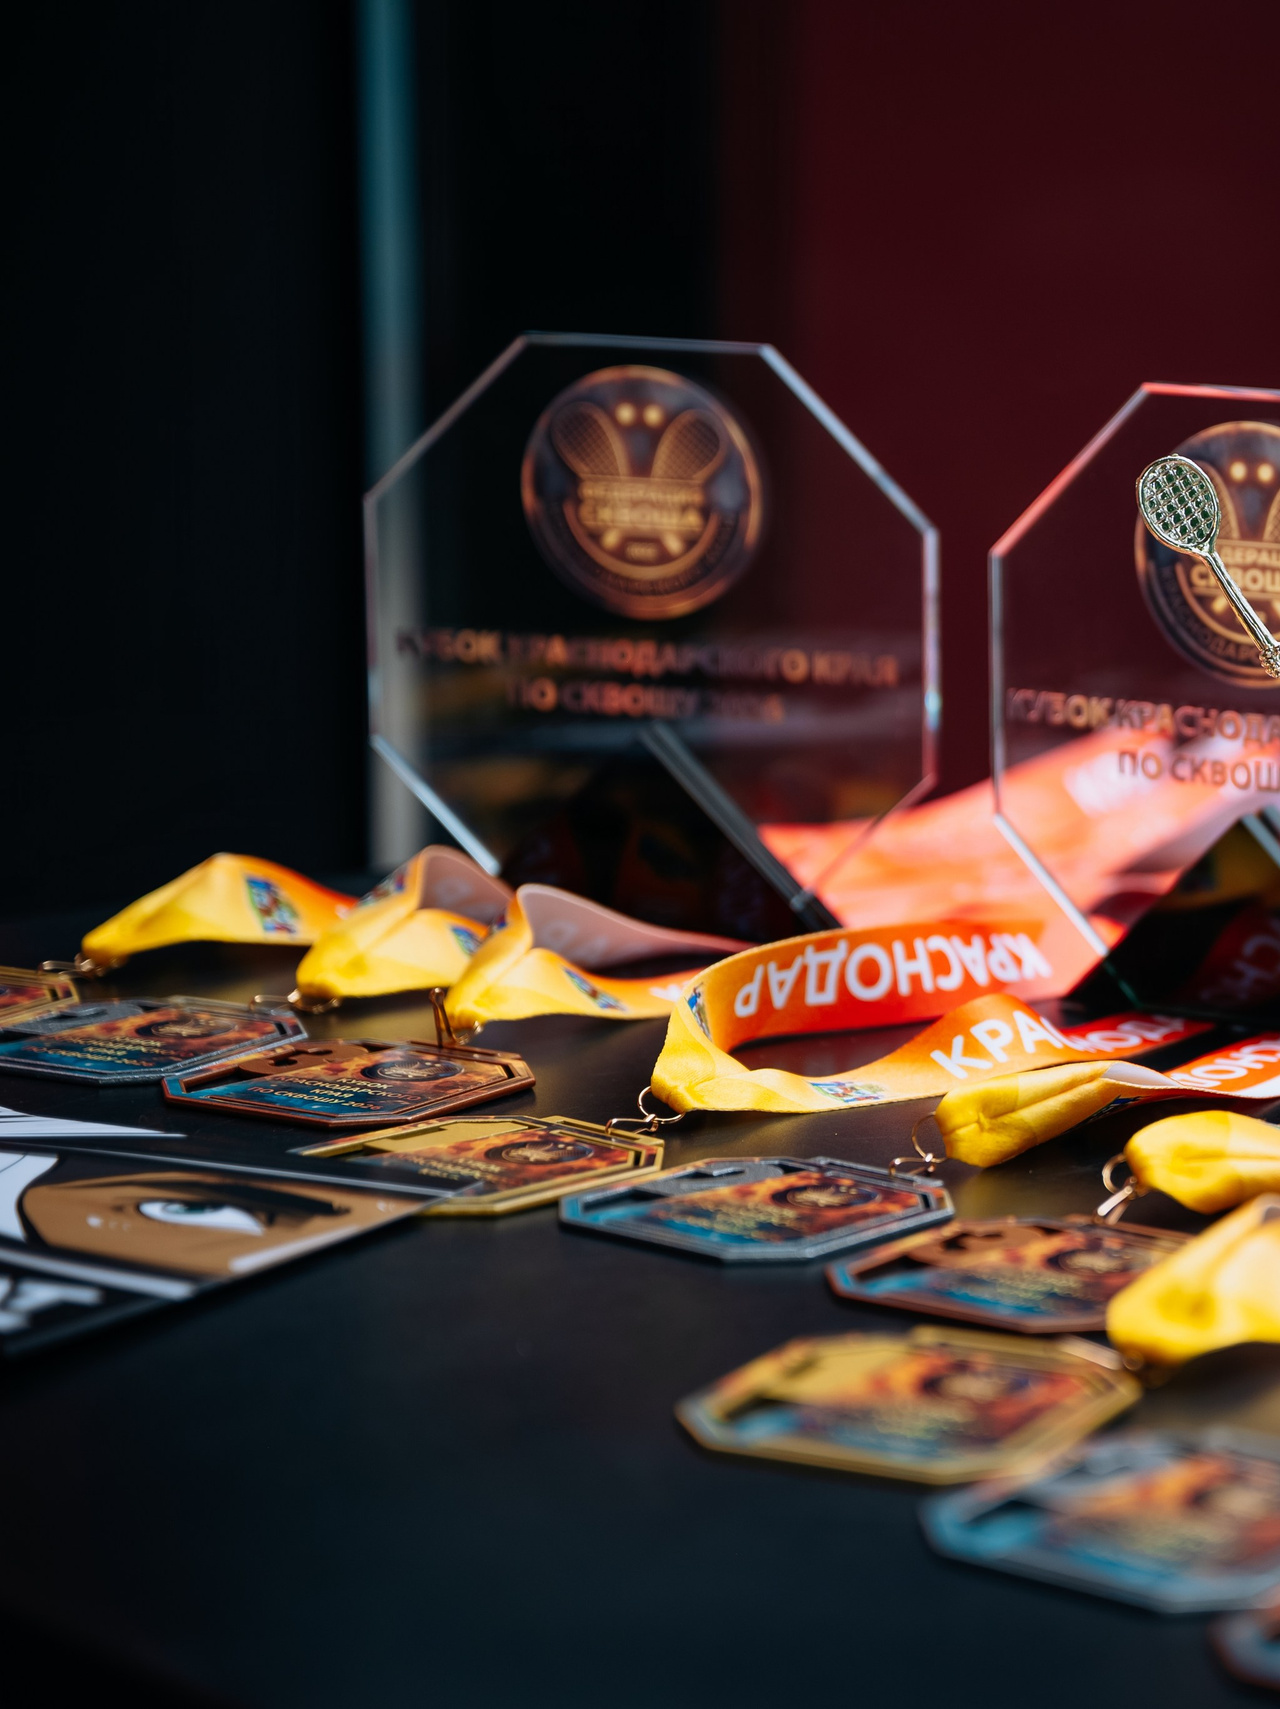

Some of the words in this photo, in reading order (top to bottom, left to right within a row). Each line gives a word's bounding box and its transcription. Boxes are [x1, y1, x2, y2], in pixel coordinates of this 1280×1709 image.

[1119, 748, 1162, 780] ПО
[734, 932, 1053, 1018] КРАСНОДАР
[248, 1086, 275, 1094] ПО
[276, 1089, 343, 1104] СКВОШУ
[342, 1100, 383, 1111] 2026
